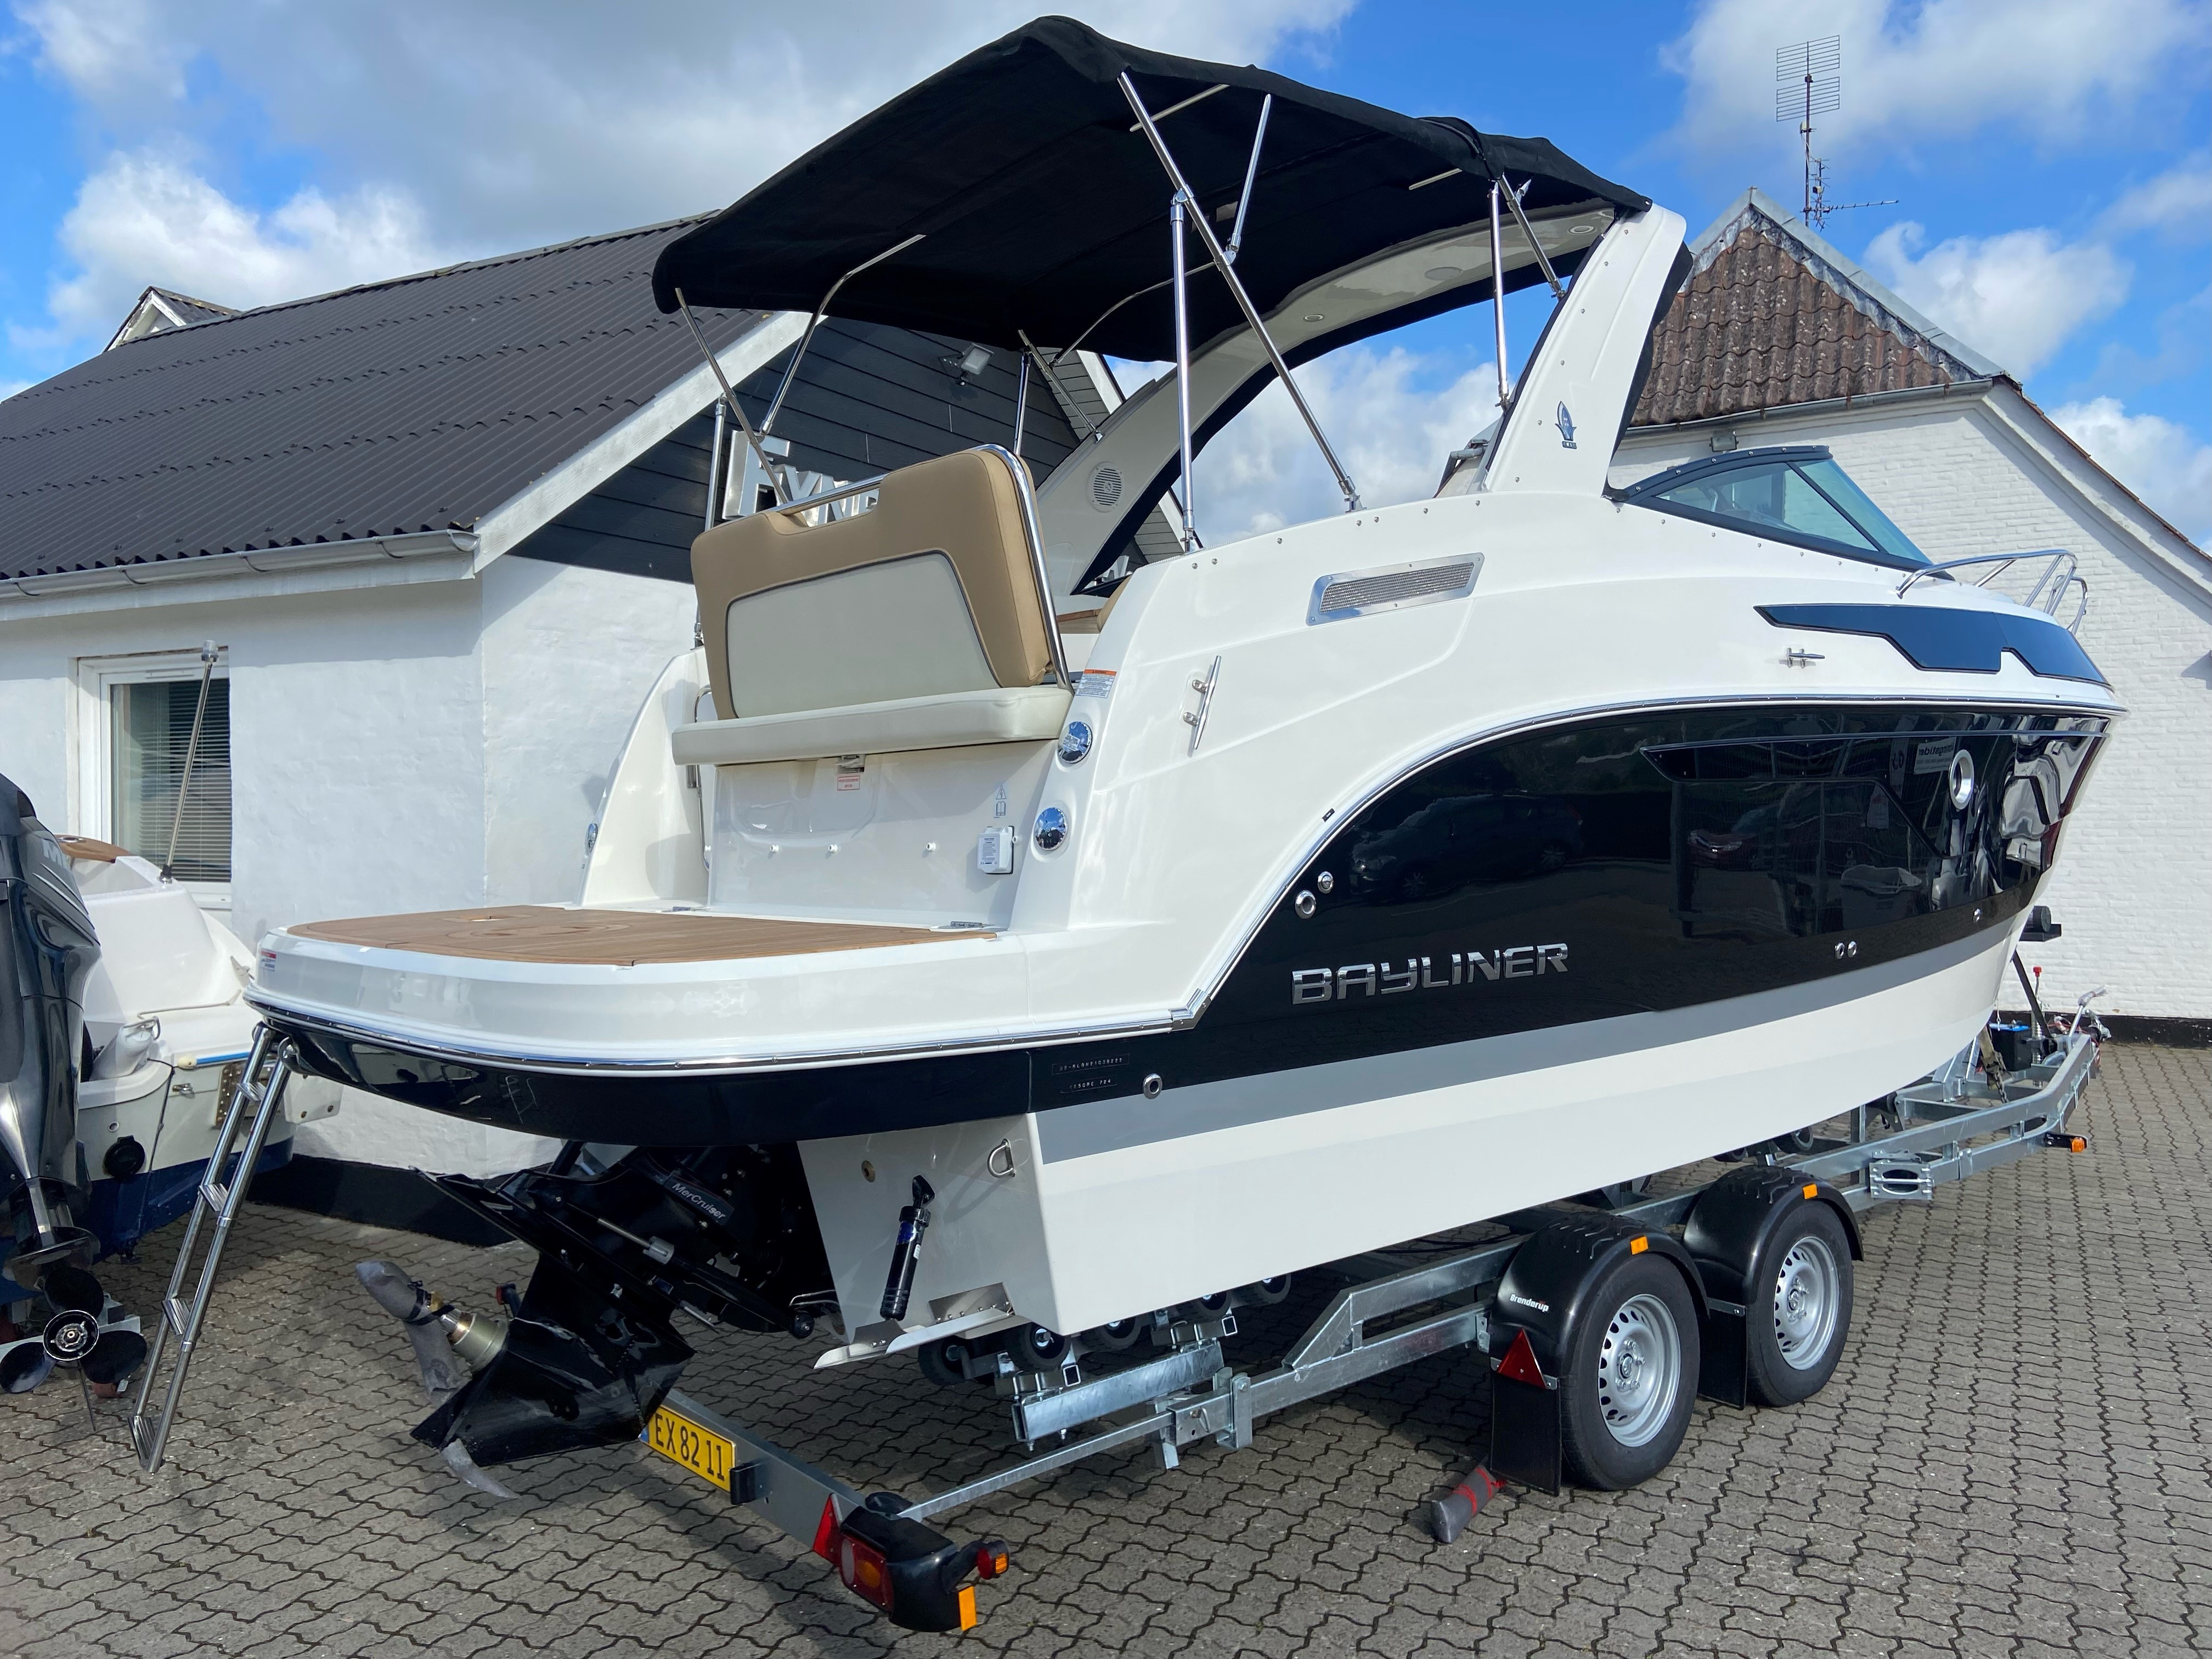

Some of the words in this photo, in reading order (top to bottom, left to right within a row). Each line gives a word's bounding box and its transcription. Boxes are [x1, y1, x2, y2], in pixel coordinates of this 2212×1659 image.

[1291, 943, 1569, 1005] BAYLINER
[672, 1183, 726, 1219] MerCruiser
[1510, 1294, 1550, 1312] Brenderup
